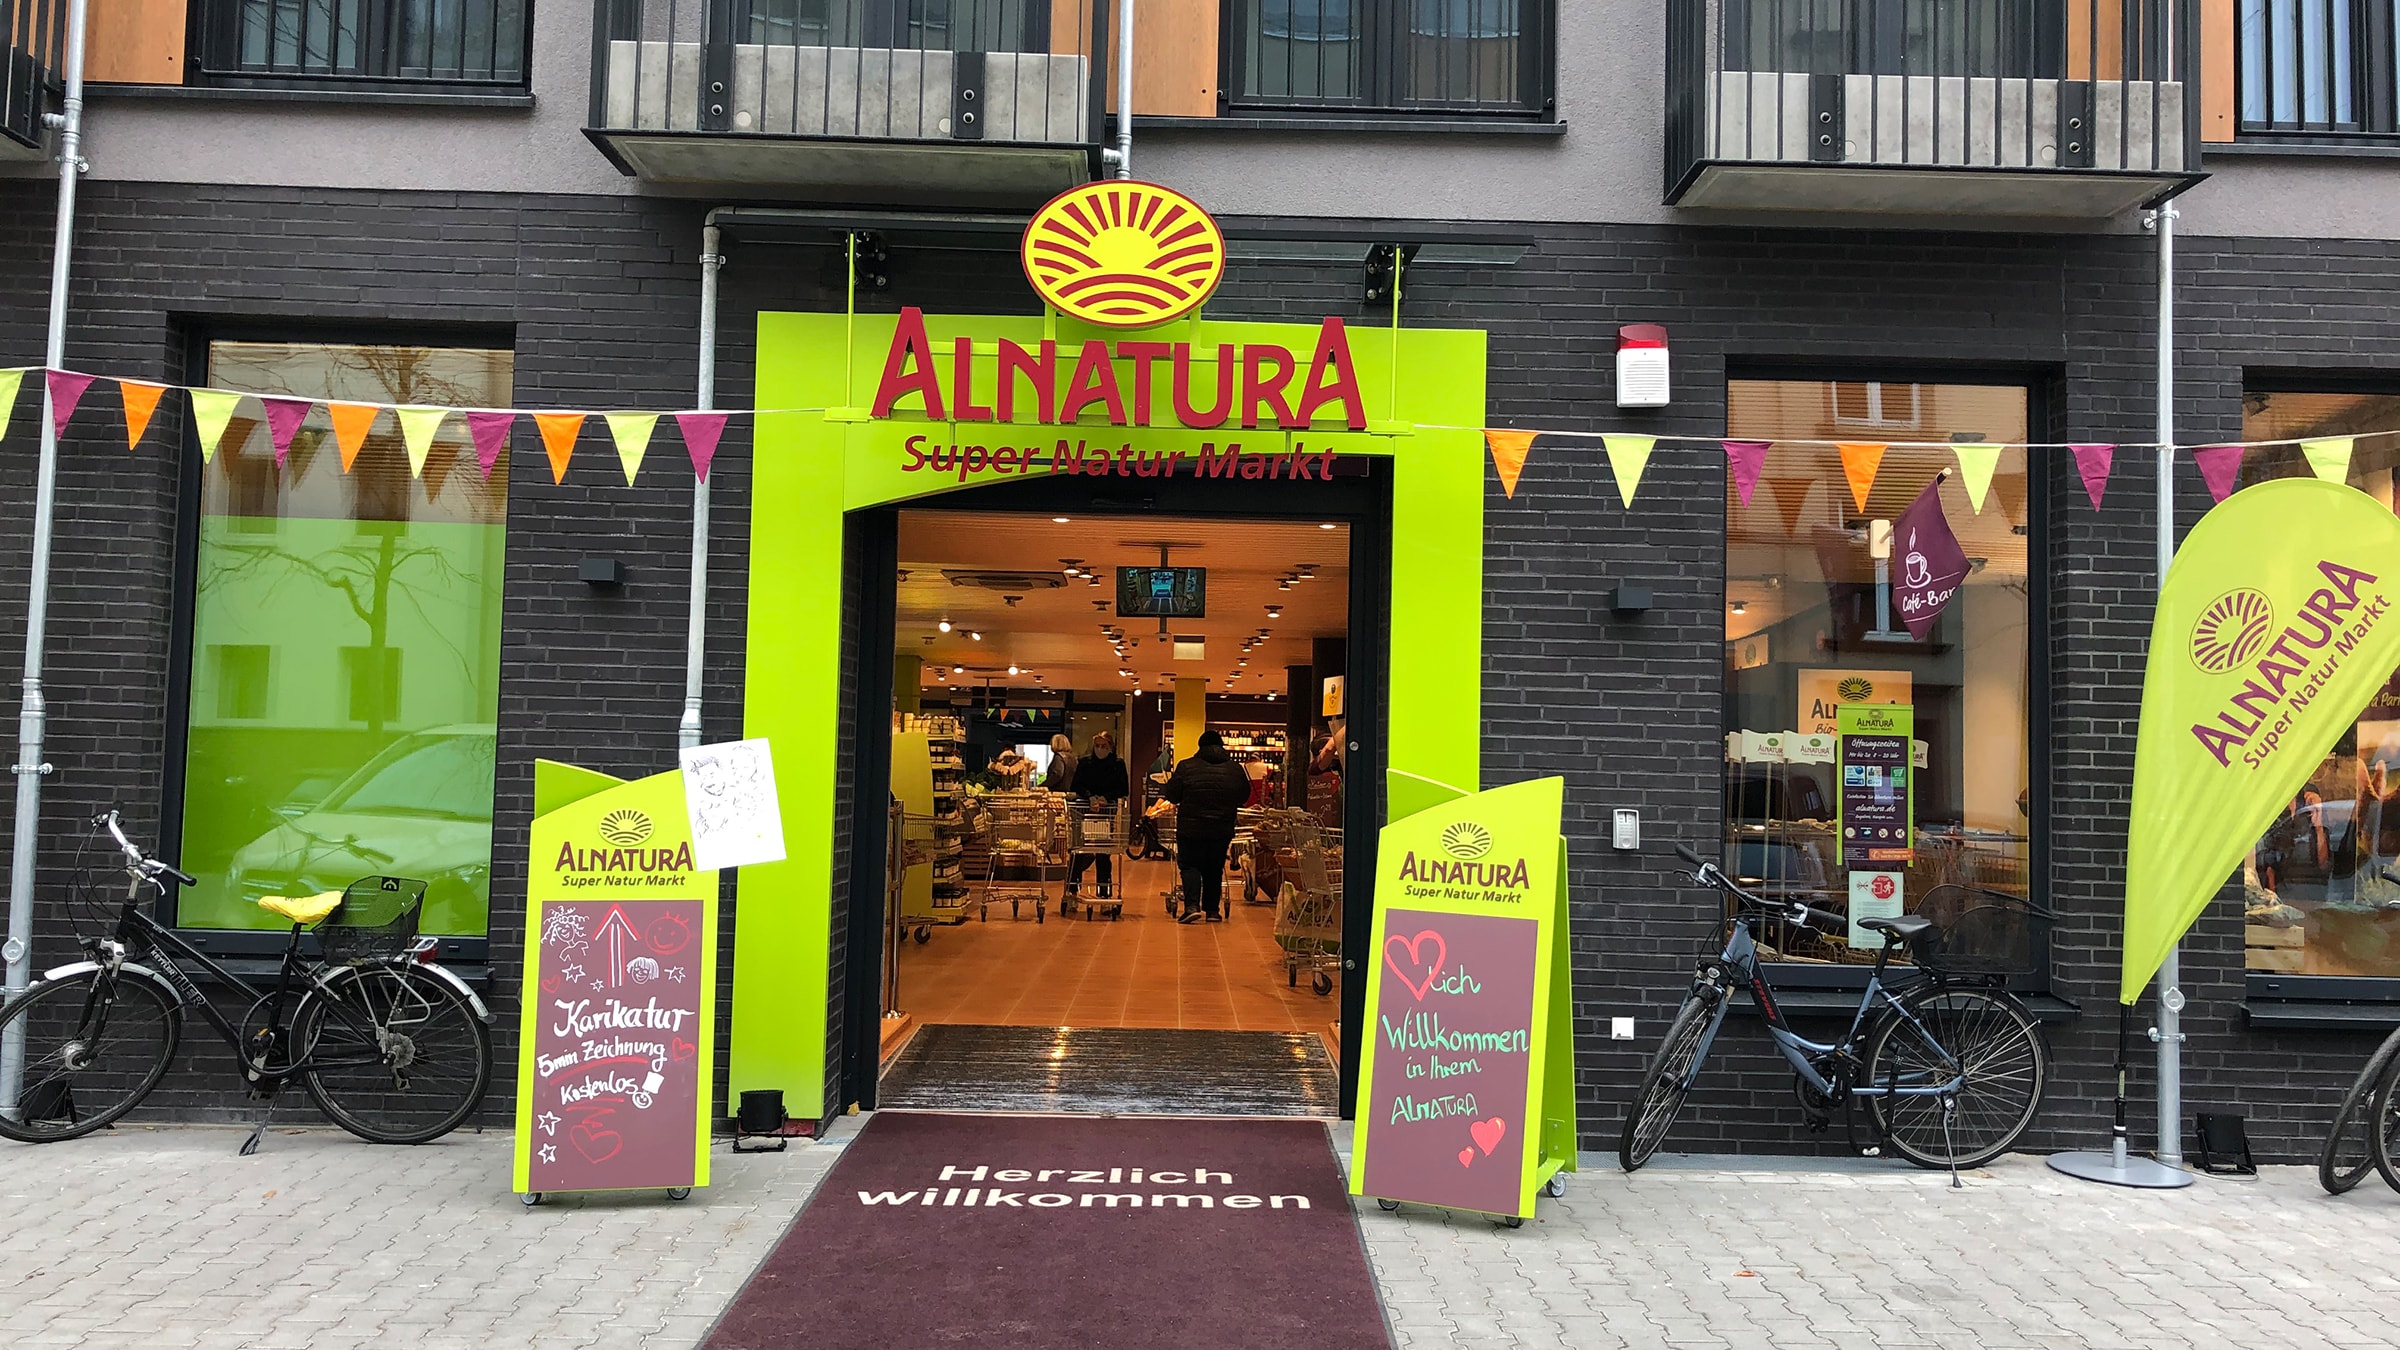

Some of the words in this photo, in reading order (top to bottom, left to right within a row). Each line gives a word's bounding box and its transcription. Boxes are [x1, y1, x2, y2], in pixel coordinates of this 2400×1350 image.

[870, 307, 1367, 430] ALNATURA
[901, 436, 1040, 483] Super
[1052, 440, 1184, 479] Natur
[1194, 442, 1337, 481] Markt
[1903, 587, 1956, 613] Café-Bar
[2190, 560, 2378, 768] ALNATURA
[2243, 710, 2294, 770] Super
[2288, 654, 2340, 714] Natur
[2334, 594, 2392, 658] Markt
[1856, 717, 1894, 728] ALNATURA
[555, 841, 694, 871] ALNATURA
[1399, 851, 1530, 889] ALNATURA
[562, 875, 602, 888] Super
[604, 875, 643, 886] Natur
[645, 875, 686, 886] Markt
[1405, 885, 1442, 899] Super
[1443, 888, 1480, 901] Natur
[1482, 891, 1521, 903] Markt
[554, 997, 695, 1037] Karikatur
[1382, 1007, 1529, 1053] Willkommen
[581, 1036, 668, 1072] Zeichnung
[1406, 1056, 1426, 1079] in
[1430, 1055, 1482, 1080] Ihrem
[560, 1070, 638, 1105] Kostenlos
[937, 1165, 1234, 1185] Herzlich
[857, 1188, 1312, 1209] willkommen
